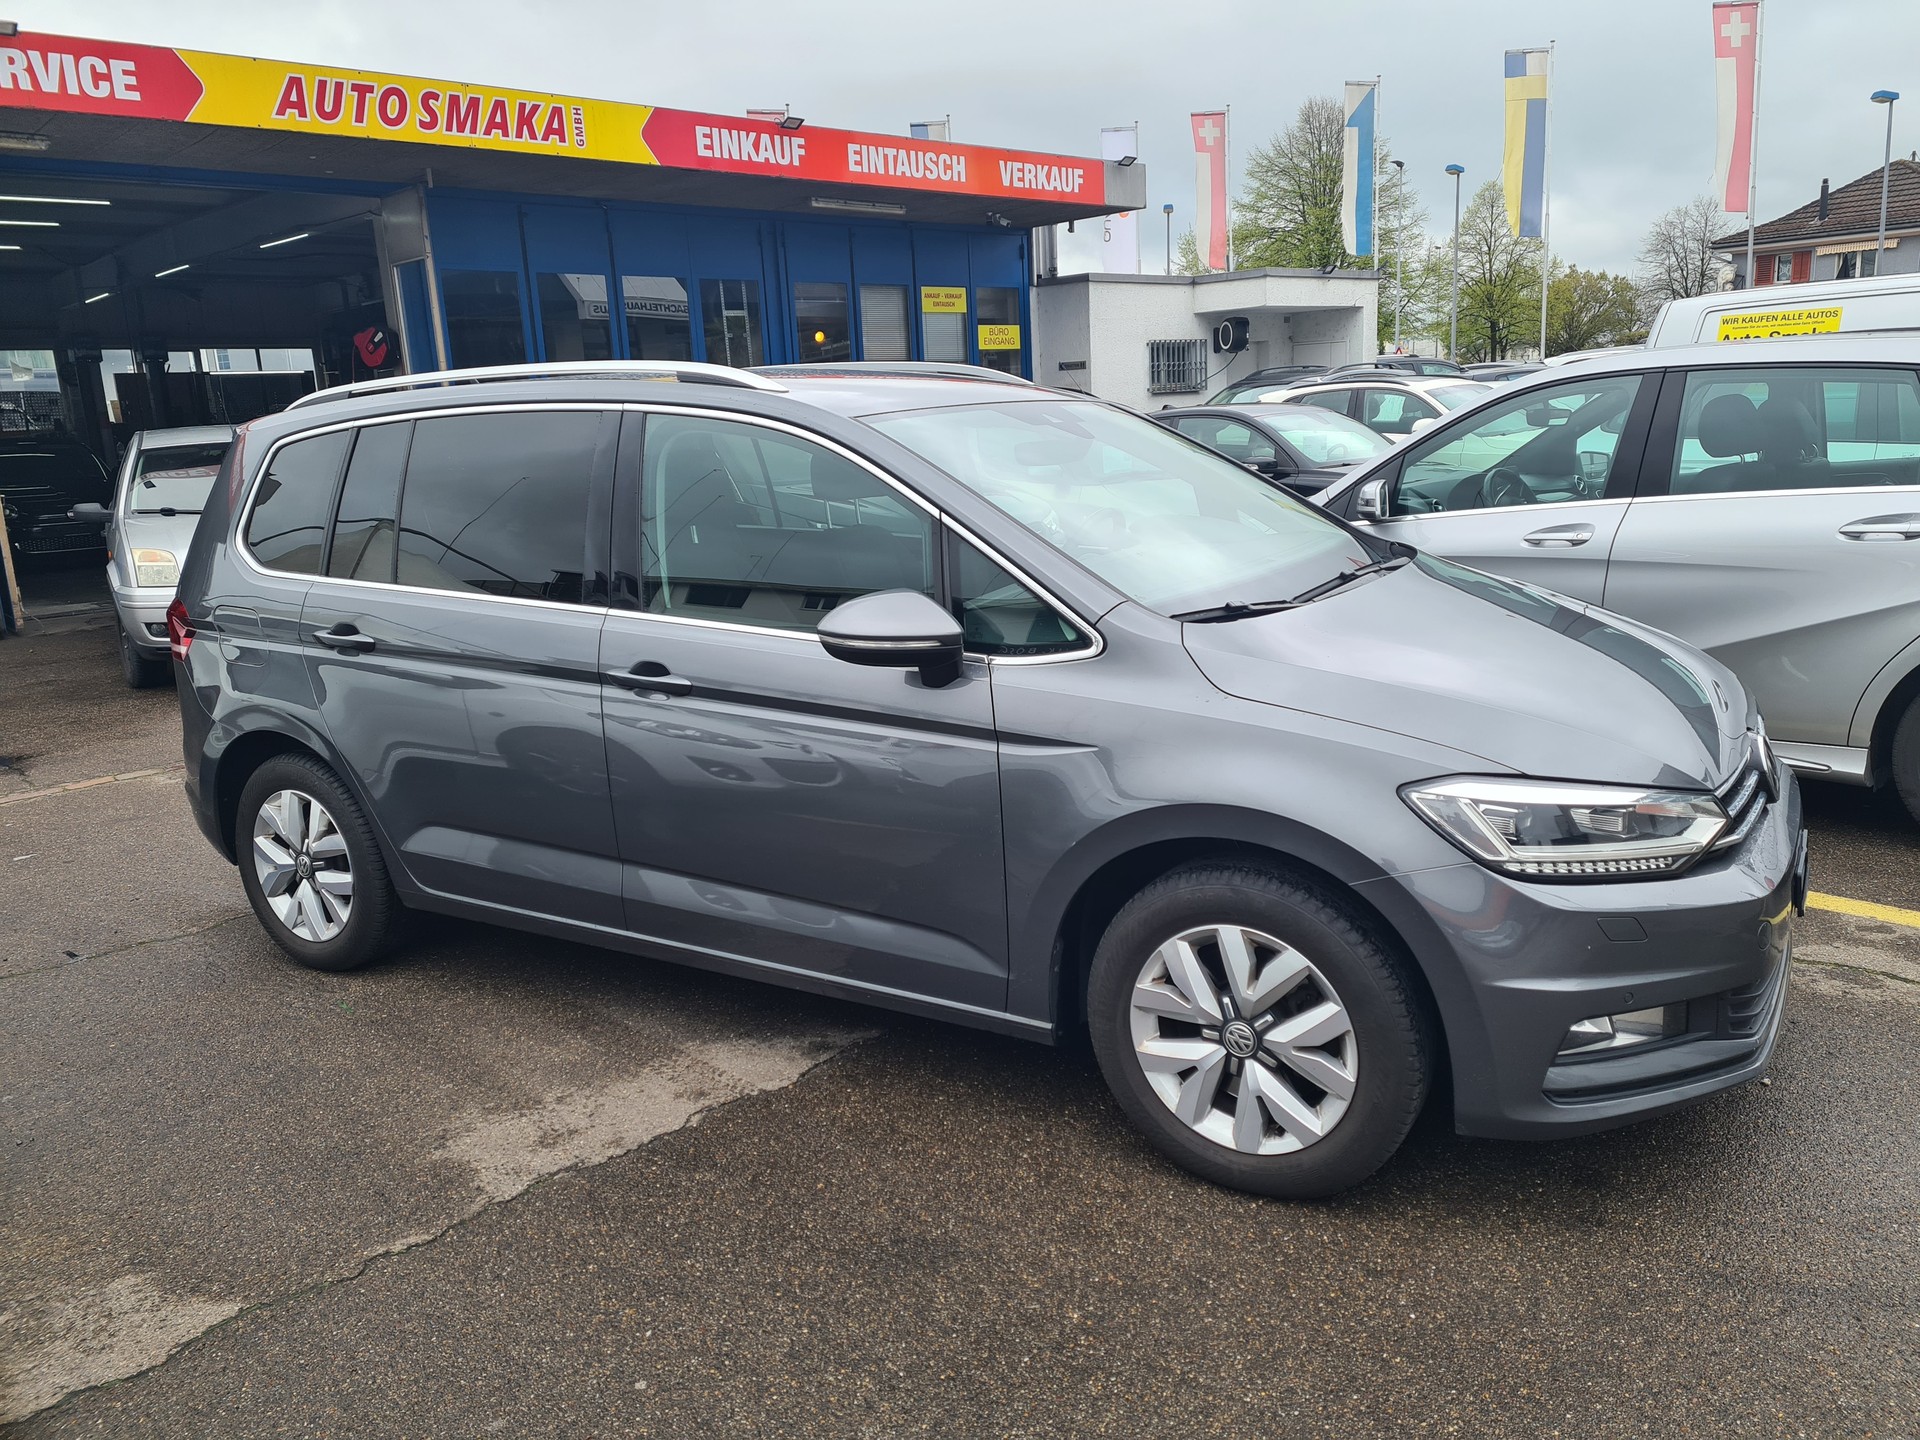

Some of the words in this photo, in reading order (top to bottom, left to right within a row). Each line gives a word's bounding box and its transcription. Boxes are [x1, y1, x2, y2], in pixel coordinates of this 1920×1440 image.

[271, 72, 409, 131] AUTO
[416, 87, 569, 146] SMAKA
[572, 105, 586, 149] GMBH
[695, 125, 806, 167] EINKAUF
[847, 143, 966, 183] EINTAUSCH
[999, 160, 1084, 193] VERKAUF
[989, 326, 1009, 336] BÜRO
[1722, 317, 1739, 326] WIR
[1742, 314, 1778, 324] KAUFEN
[1780, 312, 1804, 321] ALLE
[1806, 310, 1839, 319] AUTOS
[984, 337, 1015, 346] EINGANG
